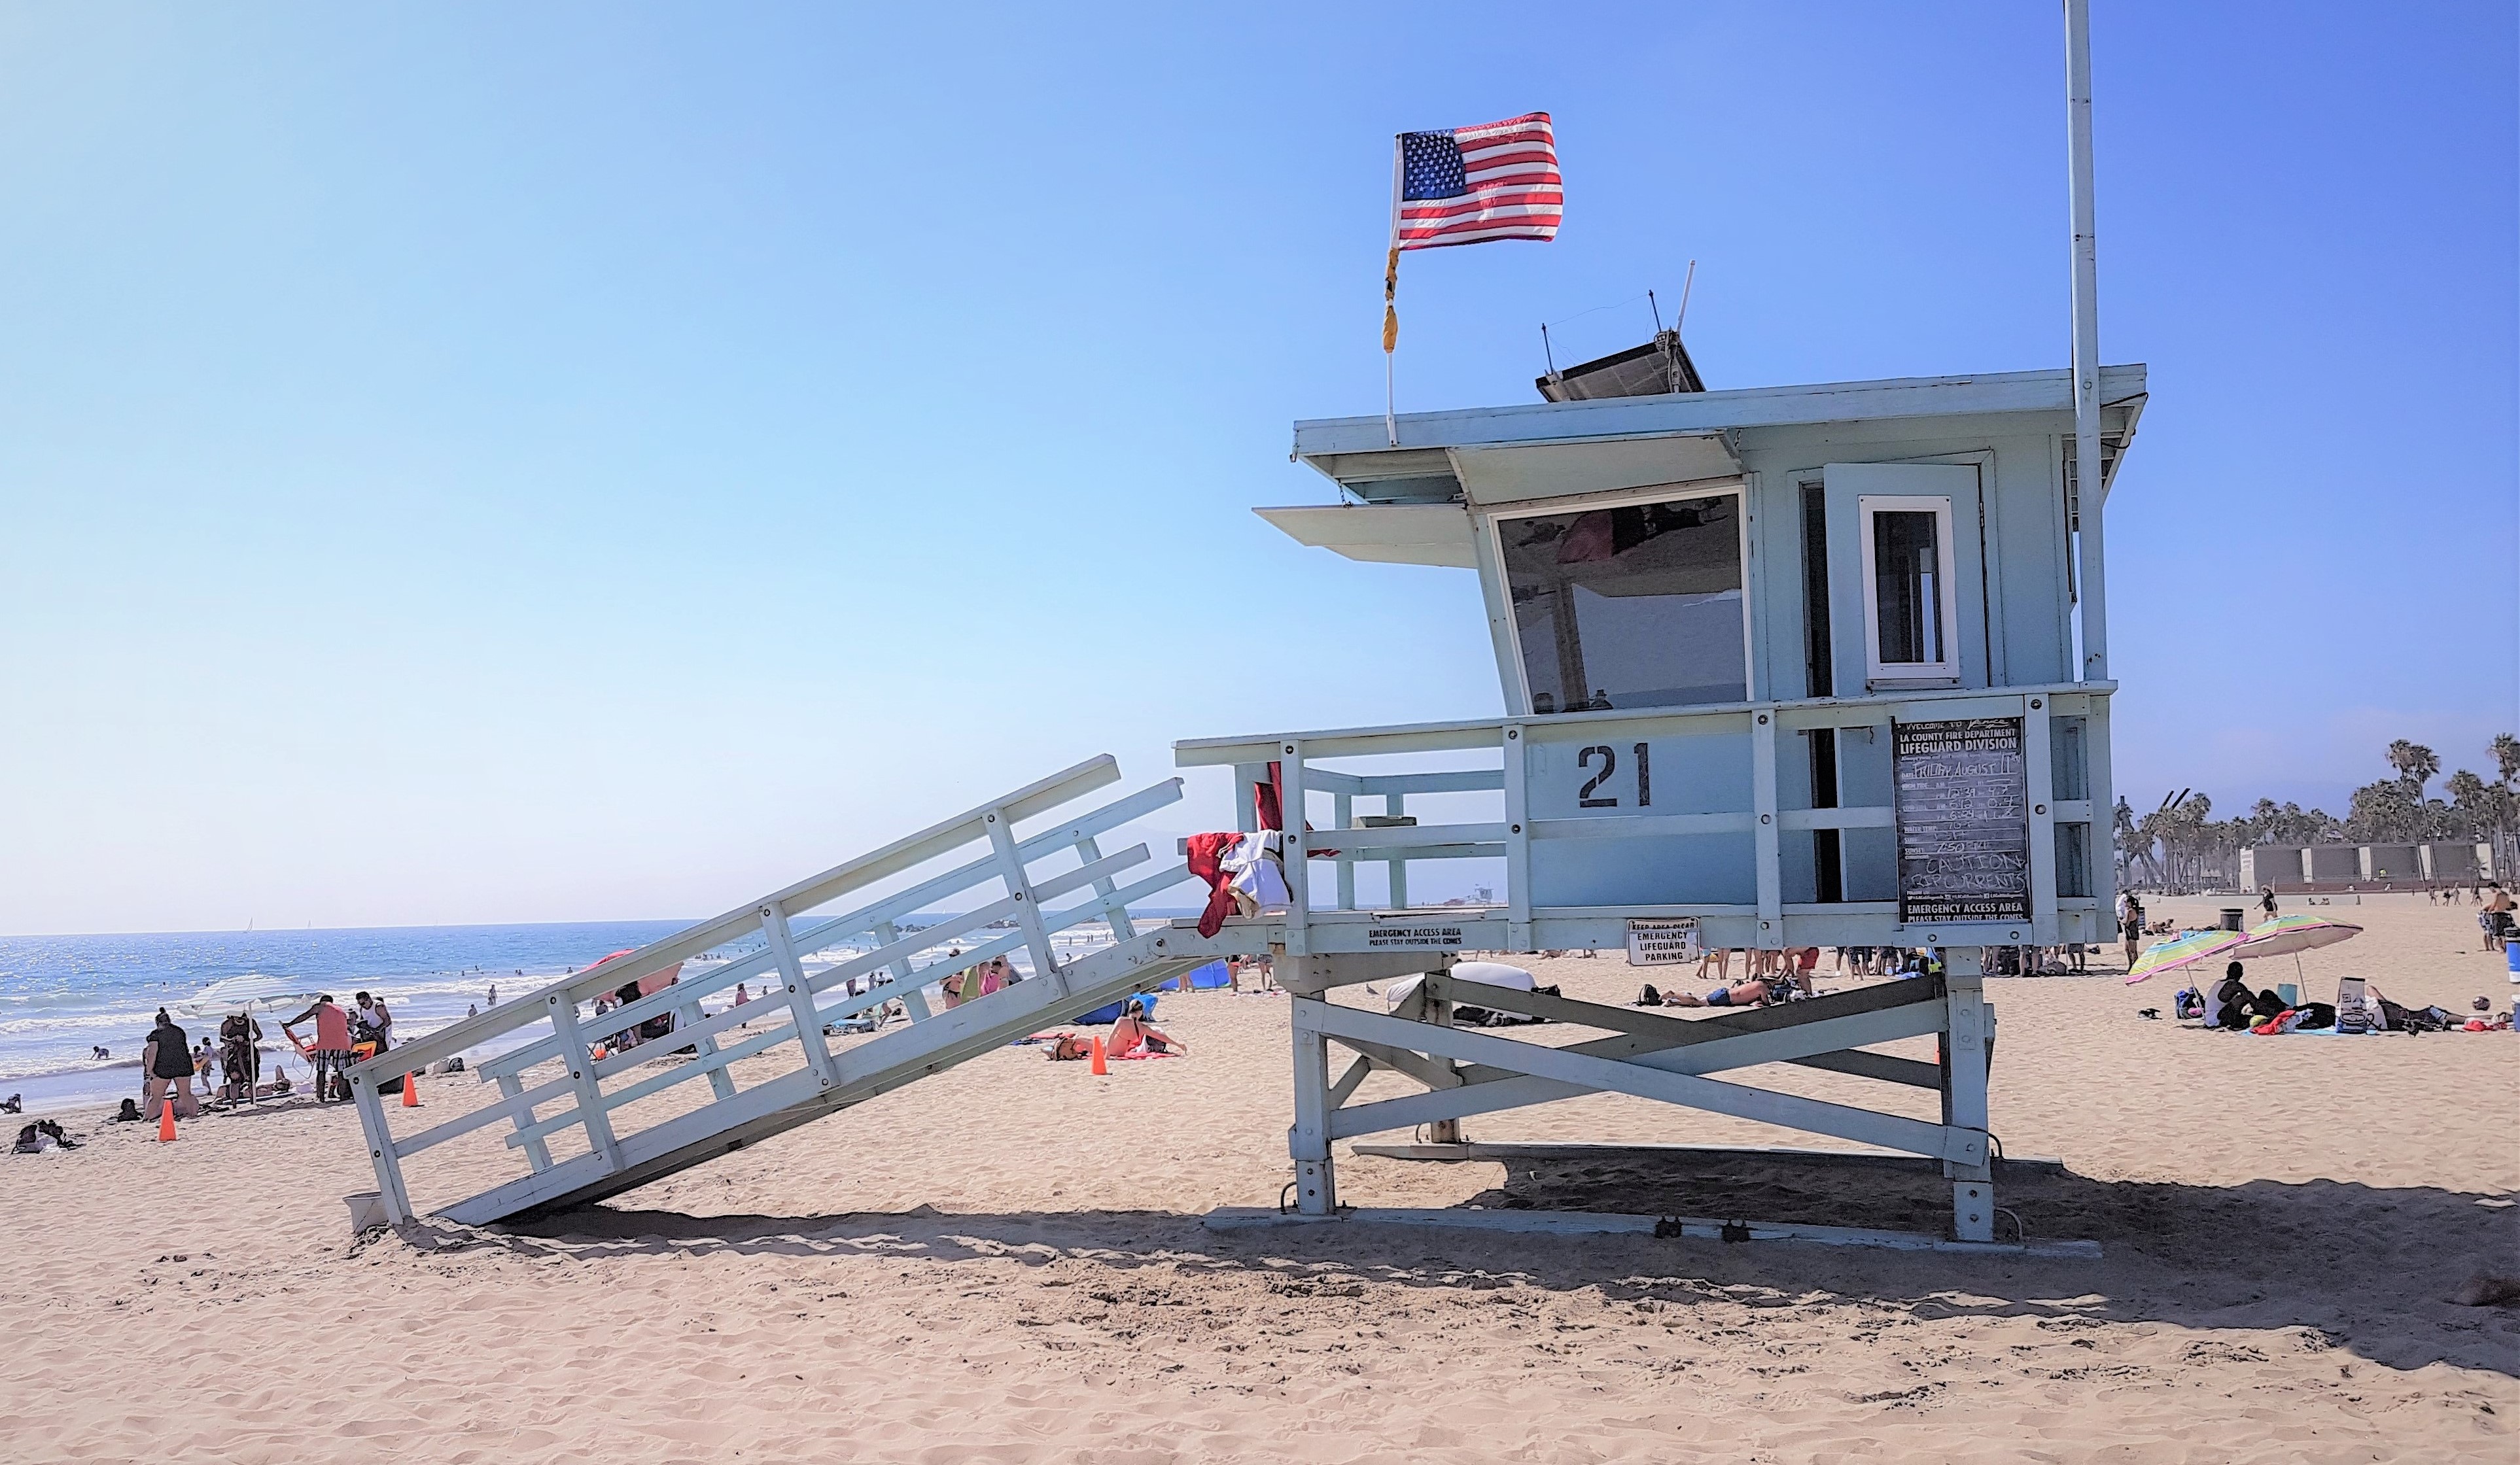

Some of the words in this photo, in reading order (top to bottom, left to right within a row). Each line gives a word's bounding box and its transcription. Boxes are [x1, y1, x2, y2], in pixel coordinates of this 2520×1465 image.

[1900, 734, 1910, 742] LA
[1911, 732, 1943, 741] COUNTY
[1945, 731, 1963, 740] FIRE
[1964, 728, 2016, 738] DEPARTMENT
[1900, 740, 1961, 754] LIFEGUARD
[1965, 737, 2017, 751] DIVISION
[1579, 742, 1650, 808] 21
[1908, 904, 1961, 914] EMERGENCY
[1963, 903, 1996, 913] ACCESS
[1999, 903, 2023, 912] AREA
[1637, 931, 1687, 940] EMERGENCY
[1640, 942, 1686, 951] LIFEGUARD
[1645, 952, 1683, 961] PARKING
